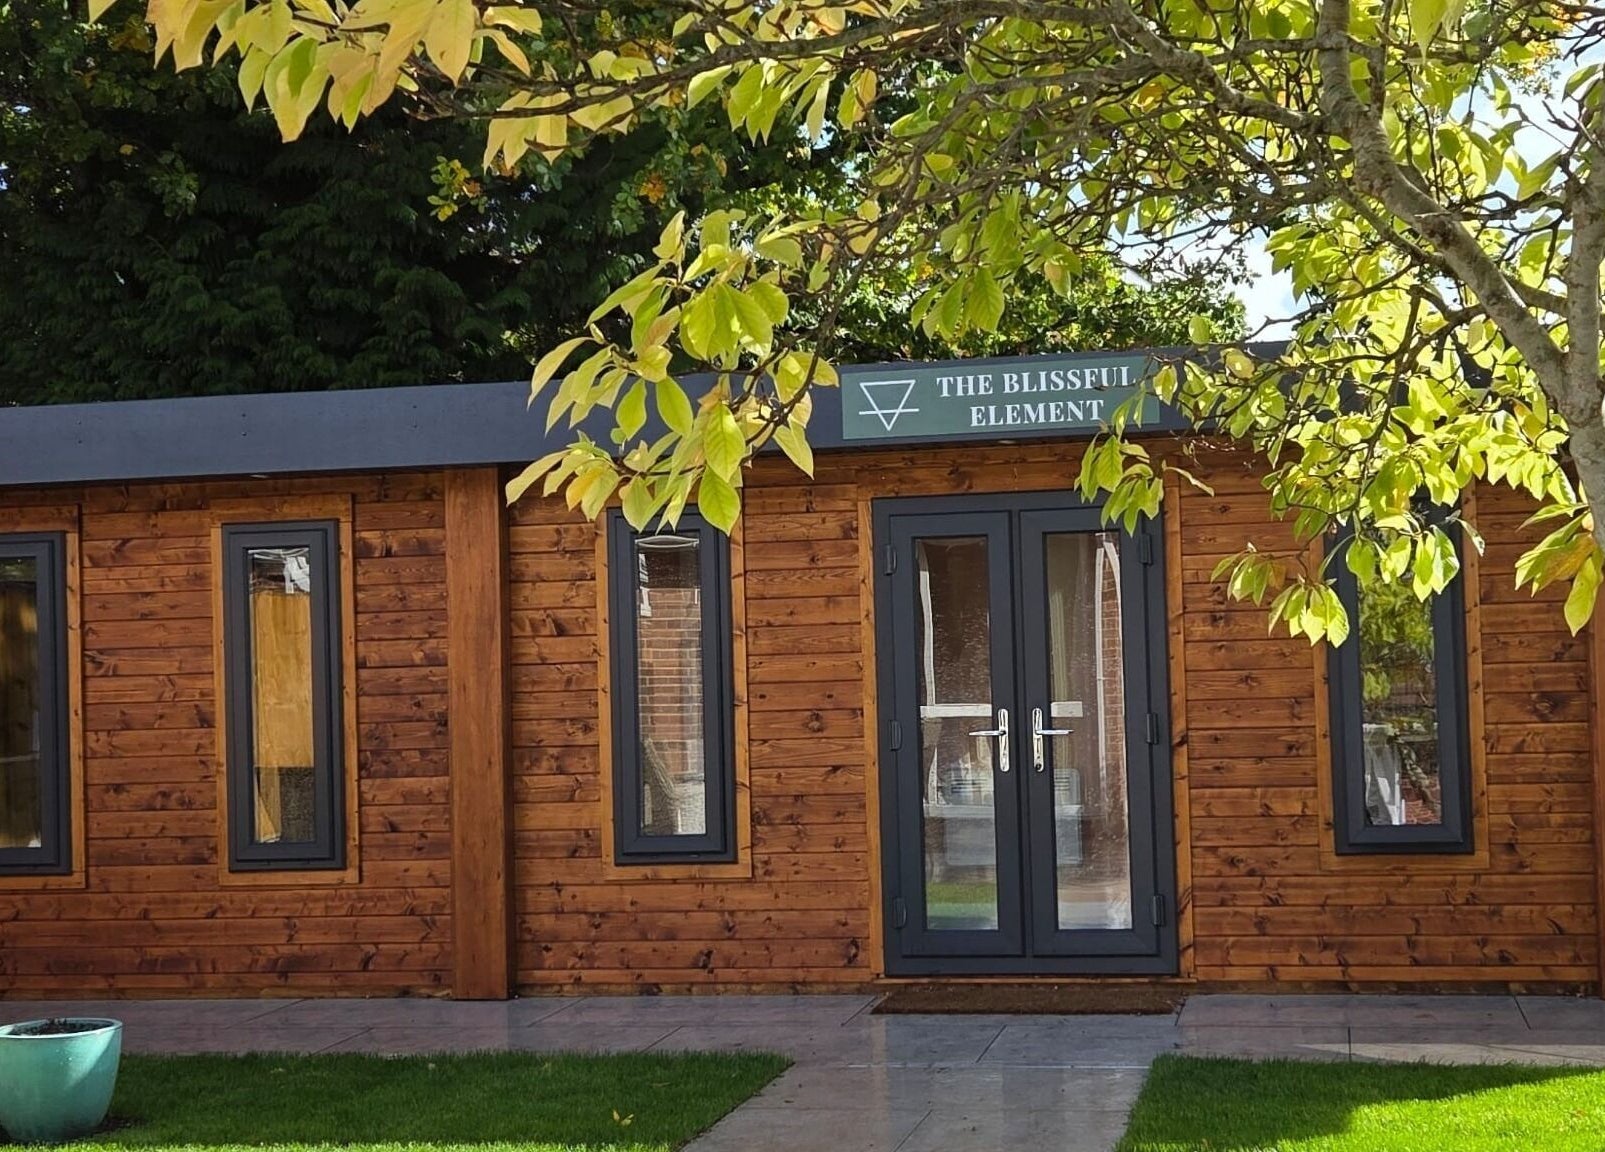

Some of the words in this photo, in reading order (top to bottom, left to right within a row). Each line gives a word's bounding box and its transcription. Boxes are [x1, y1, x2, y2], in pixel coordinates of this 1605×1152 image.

[936, 374, 993, 398] THE
[1002, 366, 1136, 394] BLISSFUL
[969, 400, 1105, 427] ELEMENT
